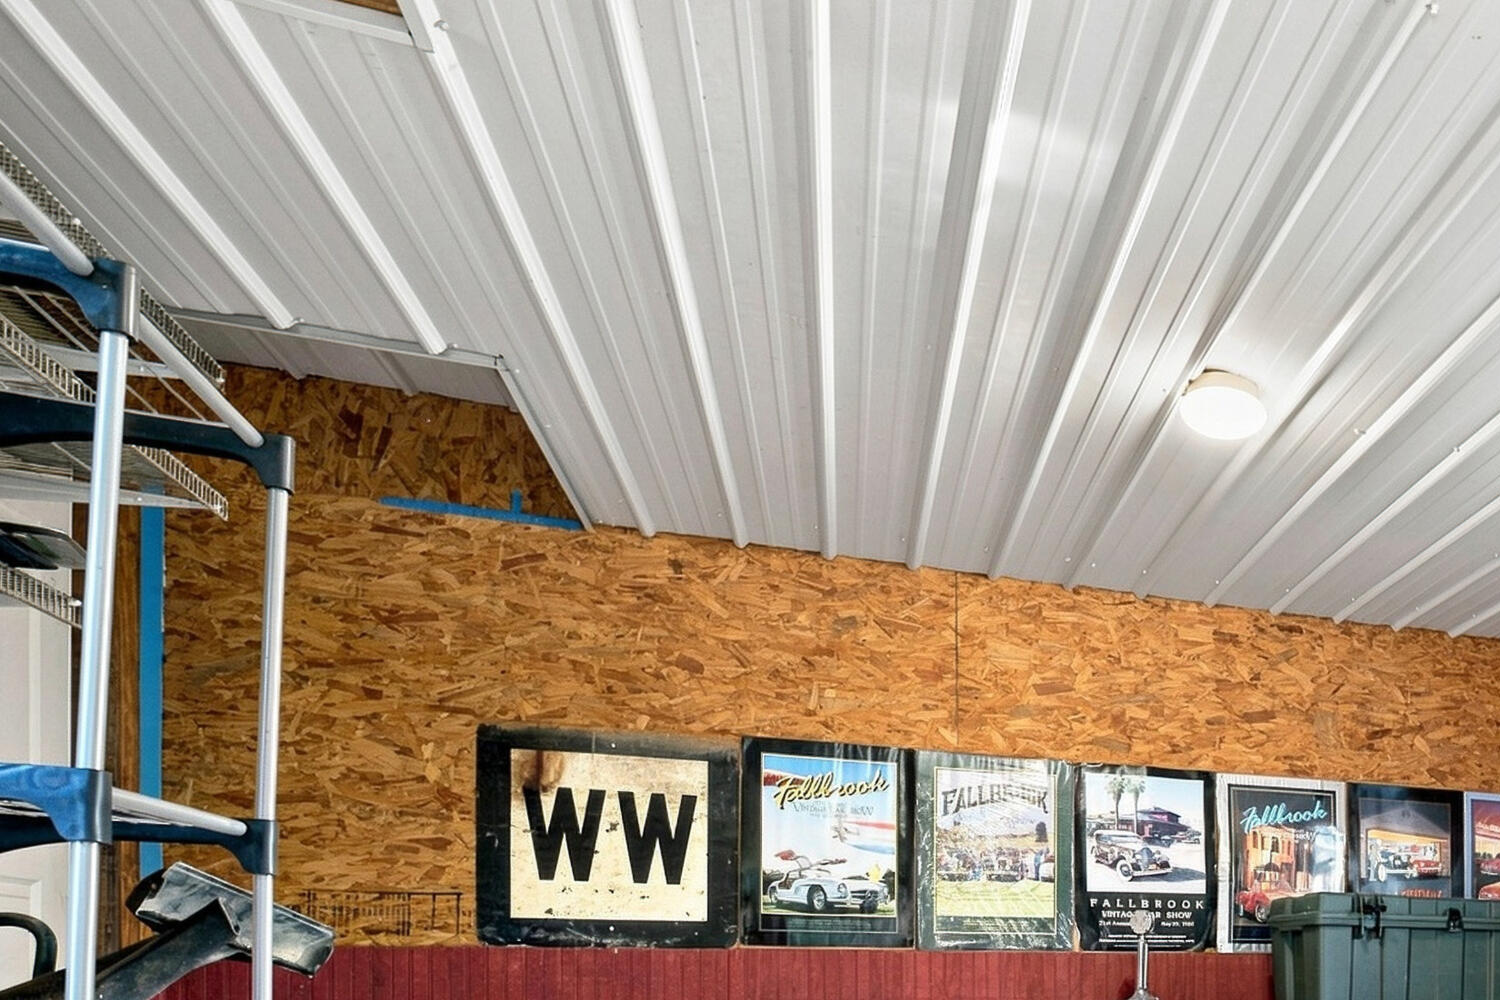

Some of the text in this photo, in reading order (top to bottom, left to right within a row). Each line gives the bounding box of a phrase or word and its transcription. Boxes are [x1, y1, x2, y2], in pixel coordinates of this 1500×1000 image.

[774, 767, 890, 810] Fallbrook
[1240, 800, 1328, 834] Fallbrook
[1089, 898, 1204, 910] FALLBROOK
[1101, 910, 1136, 919] VINTAG
[1166, 910, 1193, 919] SHOW
